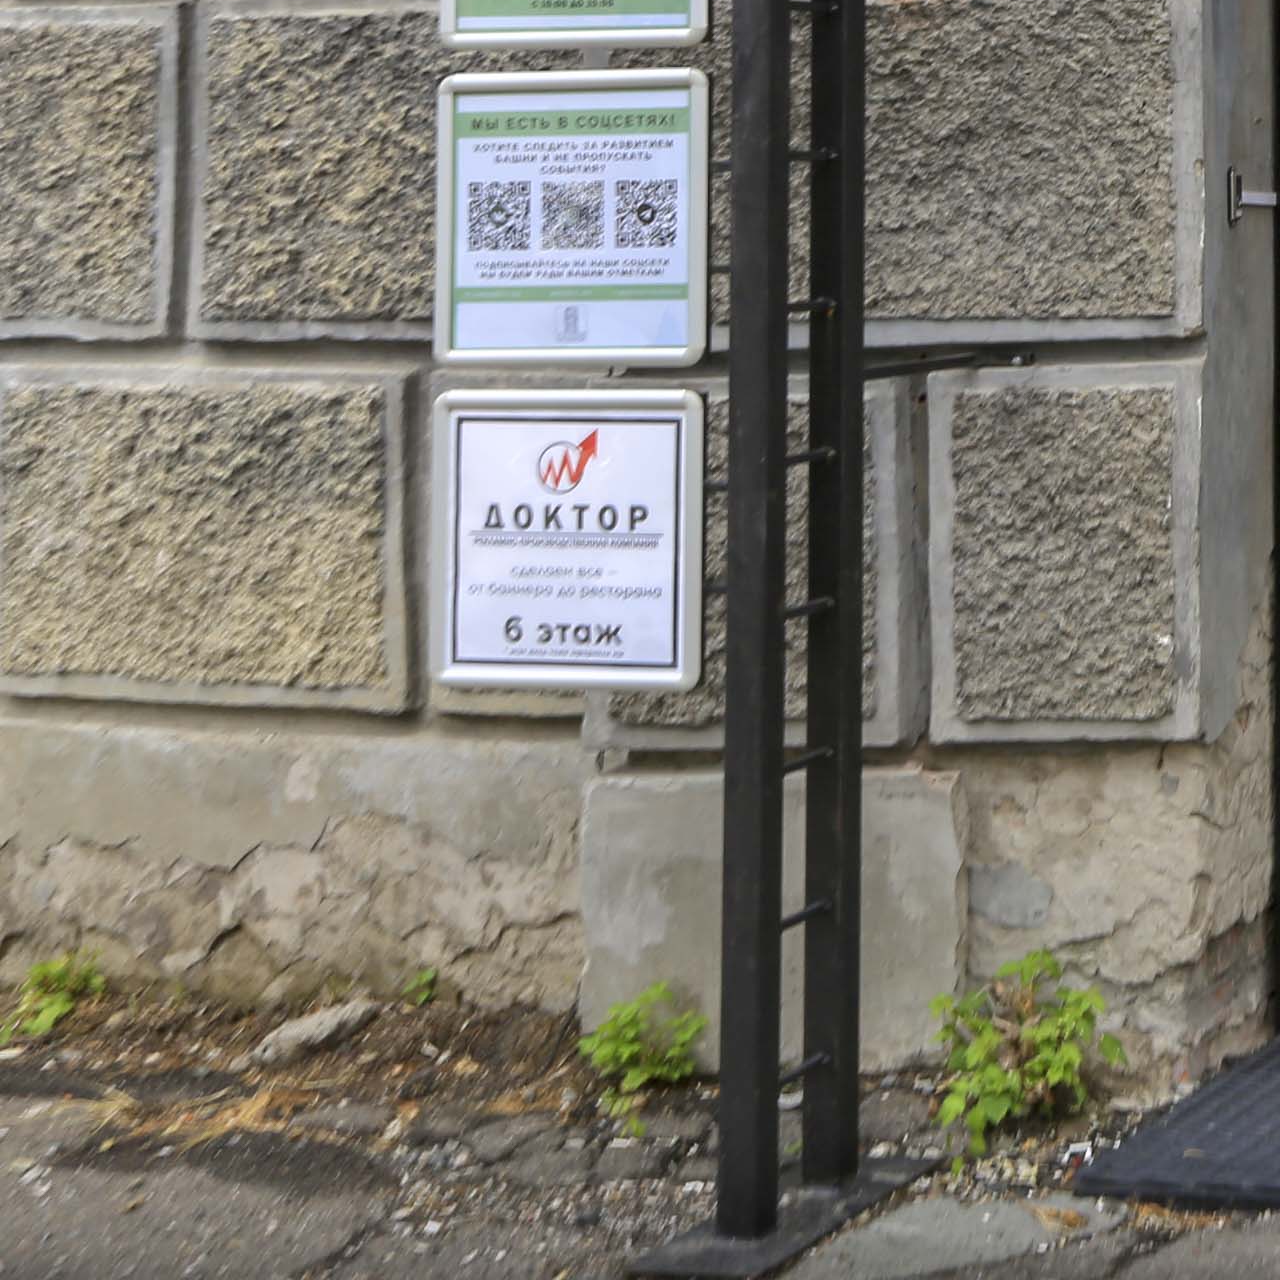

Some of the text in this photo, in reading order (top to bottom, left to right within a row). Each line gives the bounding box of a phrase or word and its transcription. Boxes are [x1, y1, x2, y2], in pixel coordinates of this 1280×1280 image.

[472, 119, 499, 131] МЫ
[507, 117, 549, 130] ЕСТЬ
[558, 116, 569, 129] В
[483, 502, 649, 531] ДОКТОР
[503, 614, 624, 646] 6 этаж
